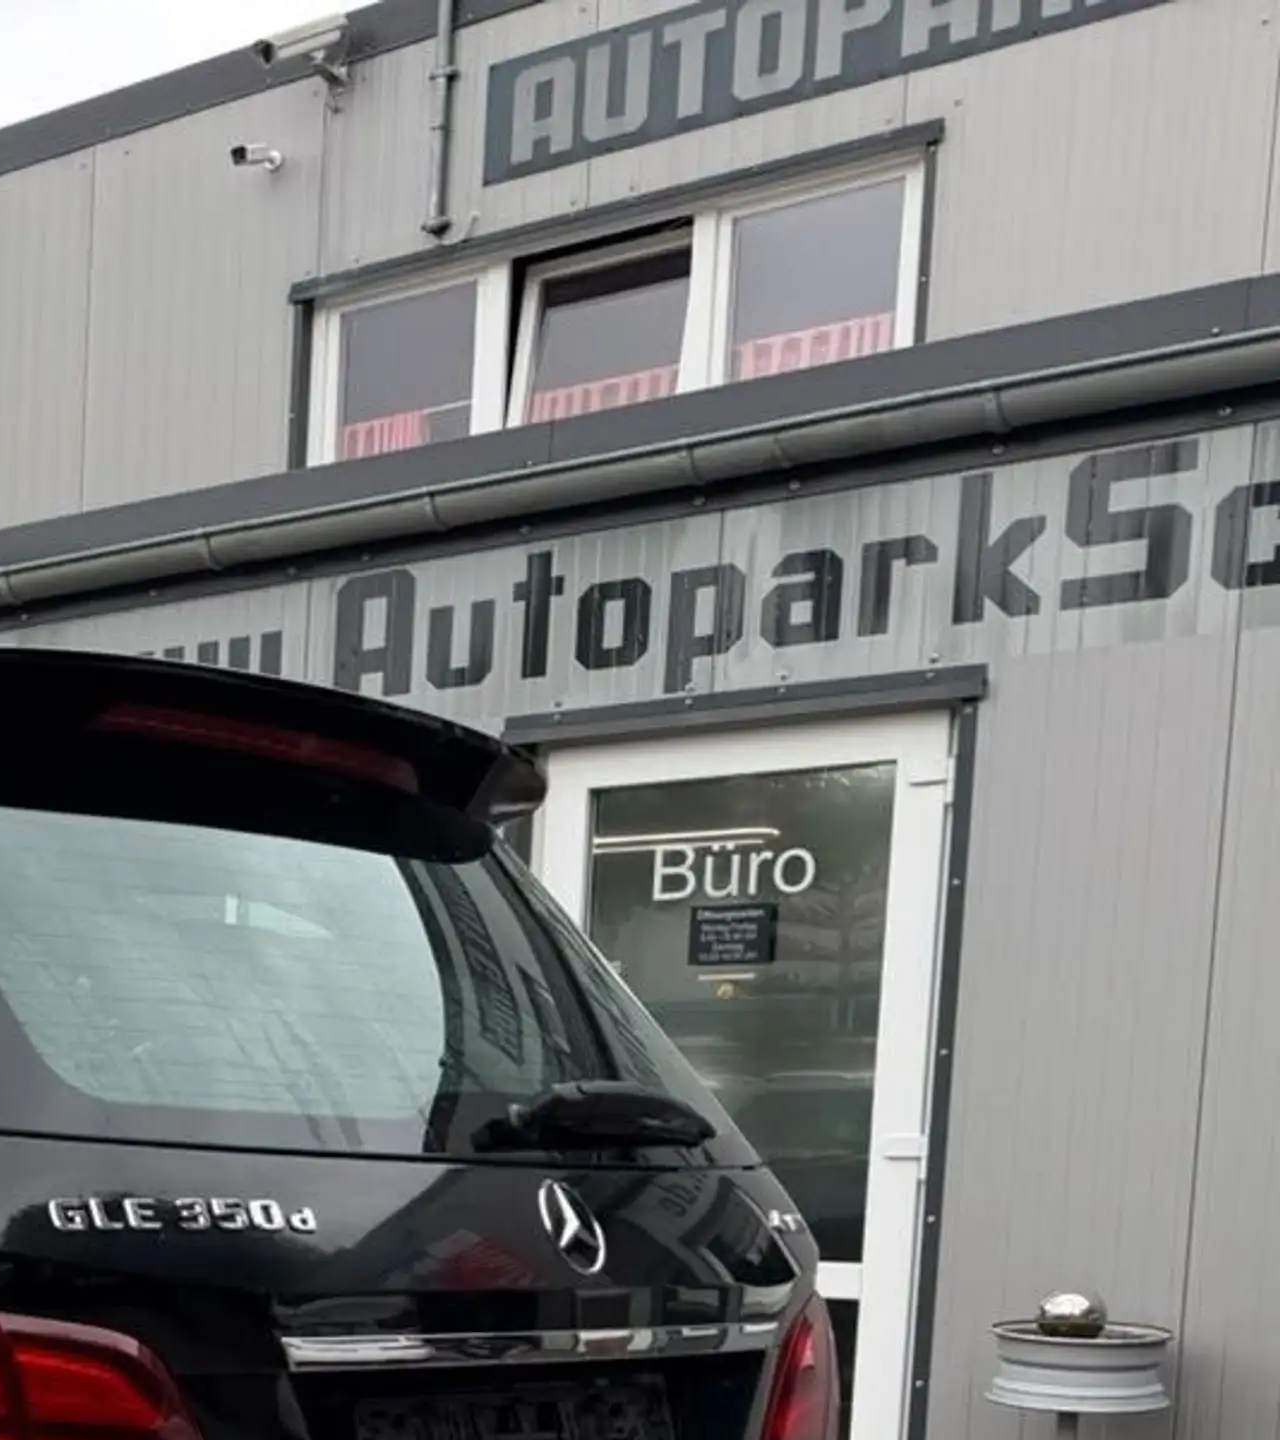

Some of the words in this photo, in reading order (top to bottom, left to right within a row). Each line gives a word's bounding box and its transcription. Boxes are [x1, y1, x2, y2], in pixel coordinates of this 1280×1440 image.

[652, 842, 816, 901] Büro
[48, 1197, 164, 1231] GLE
[174, 1196, 319, 1234] 350d
